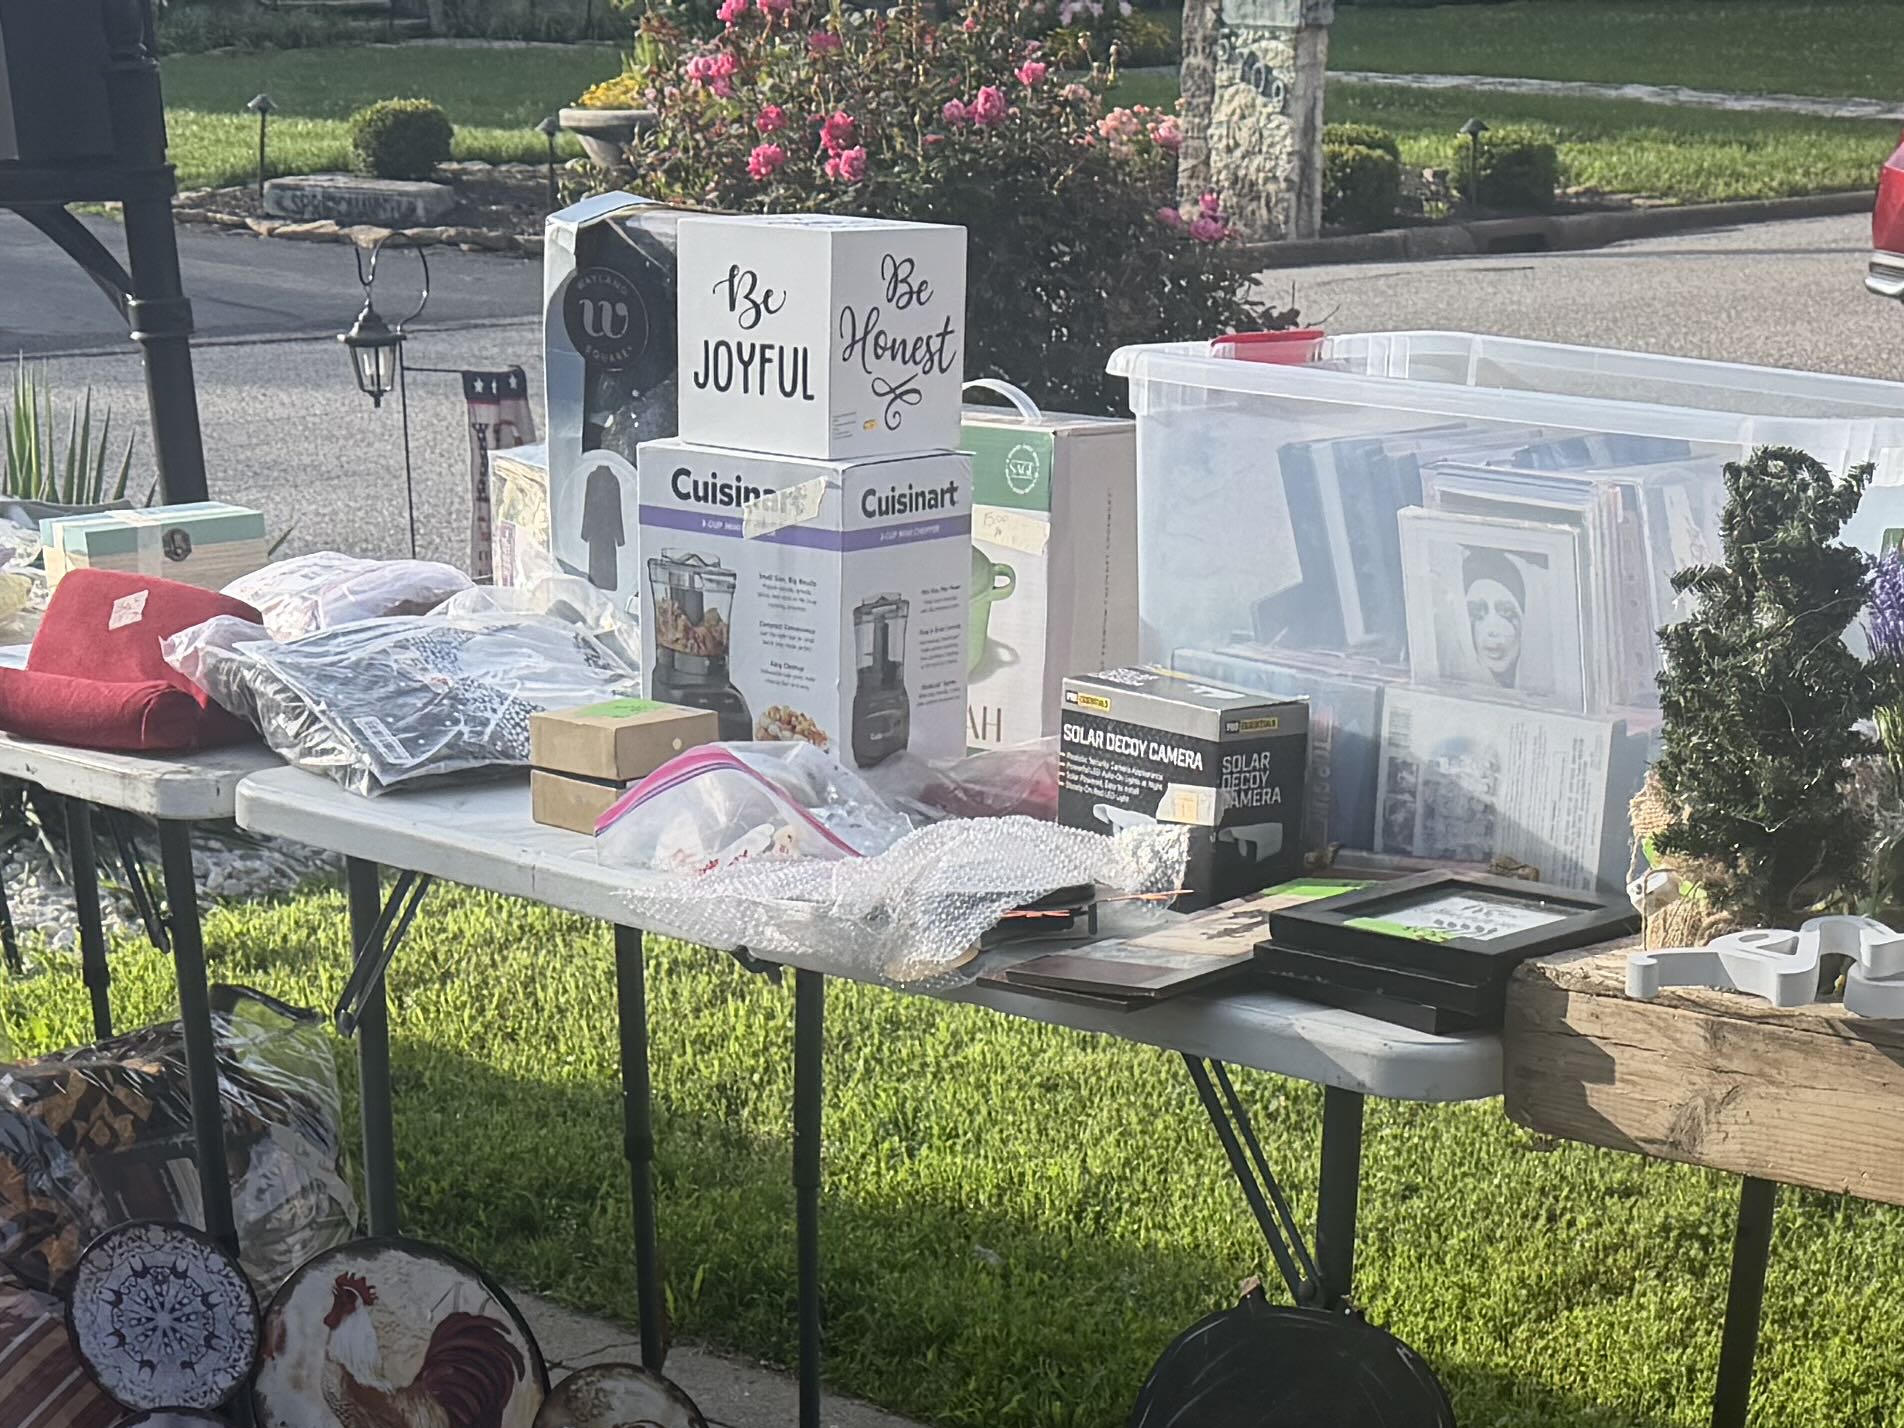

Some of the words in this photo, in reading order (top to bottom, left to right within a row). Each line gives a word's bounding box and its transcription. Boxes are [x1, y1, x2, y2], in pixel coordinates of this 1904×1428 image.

[713, 264, 787, 330] Be
[881, 253, 934, 310] Be
[839, 305, 957, 375] Honest
[694, 339, 815, 401] JOYFUL
[671, 466, 807, 517] Cuisina
[860, 480, 960, 520] Cuisinart
[1062, 723, 1104, 749] SOLAR
[1106, 731, 1149, 759] DECOY
[1148, 742, 1204, 772] CAMERA
[1222, 751, 1271, 774] SOLAR
[1222, 770, 1270, 790] DECOY
[1230, 786, 1282, 808] AMERA
